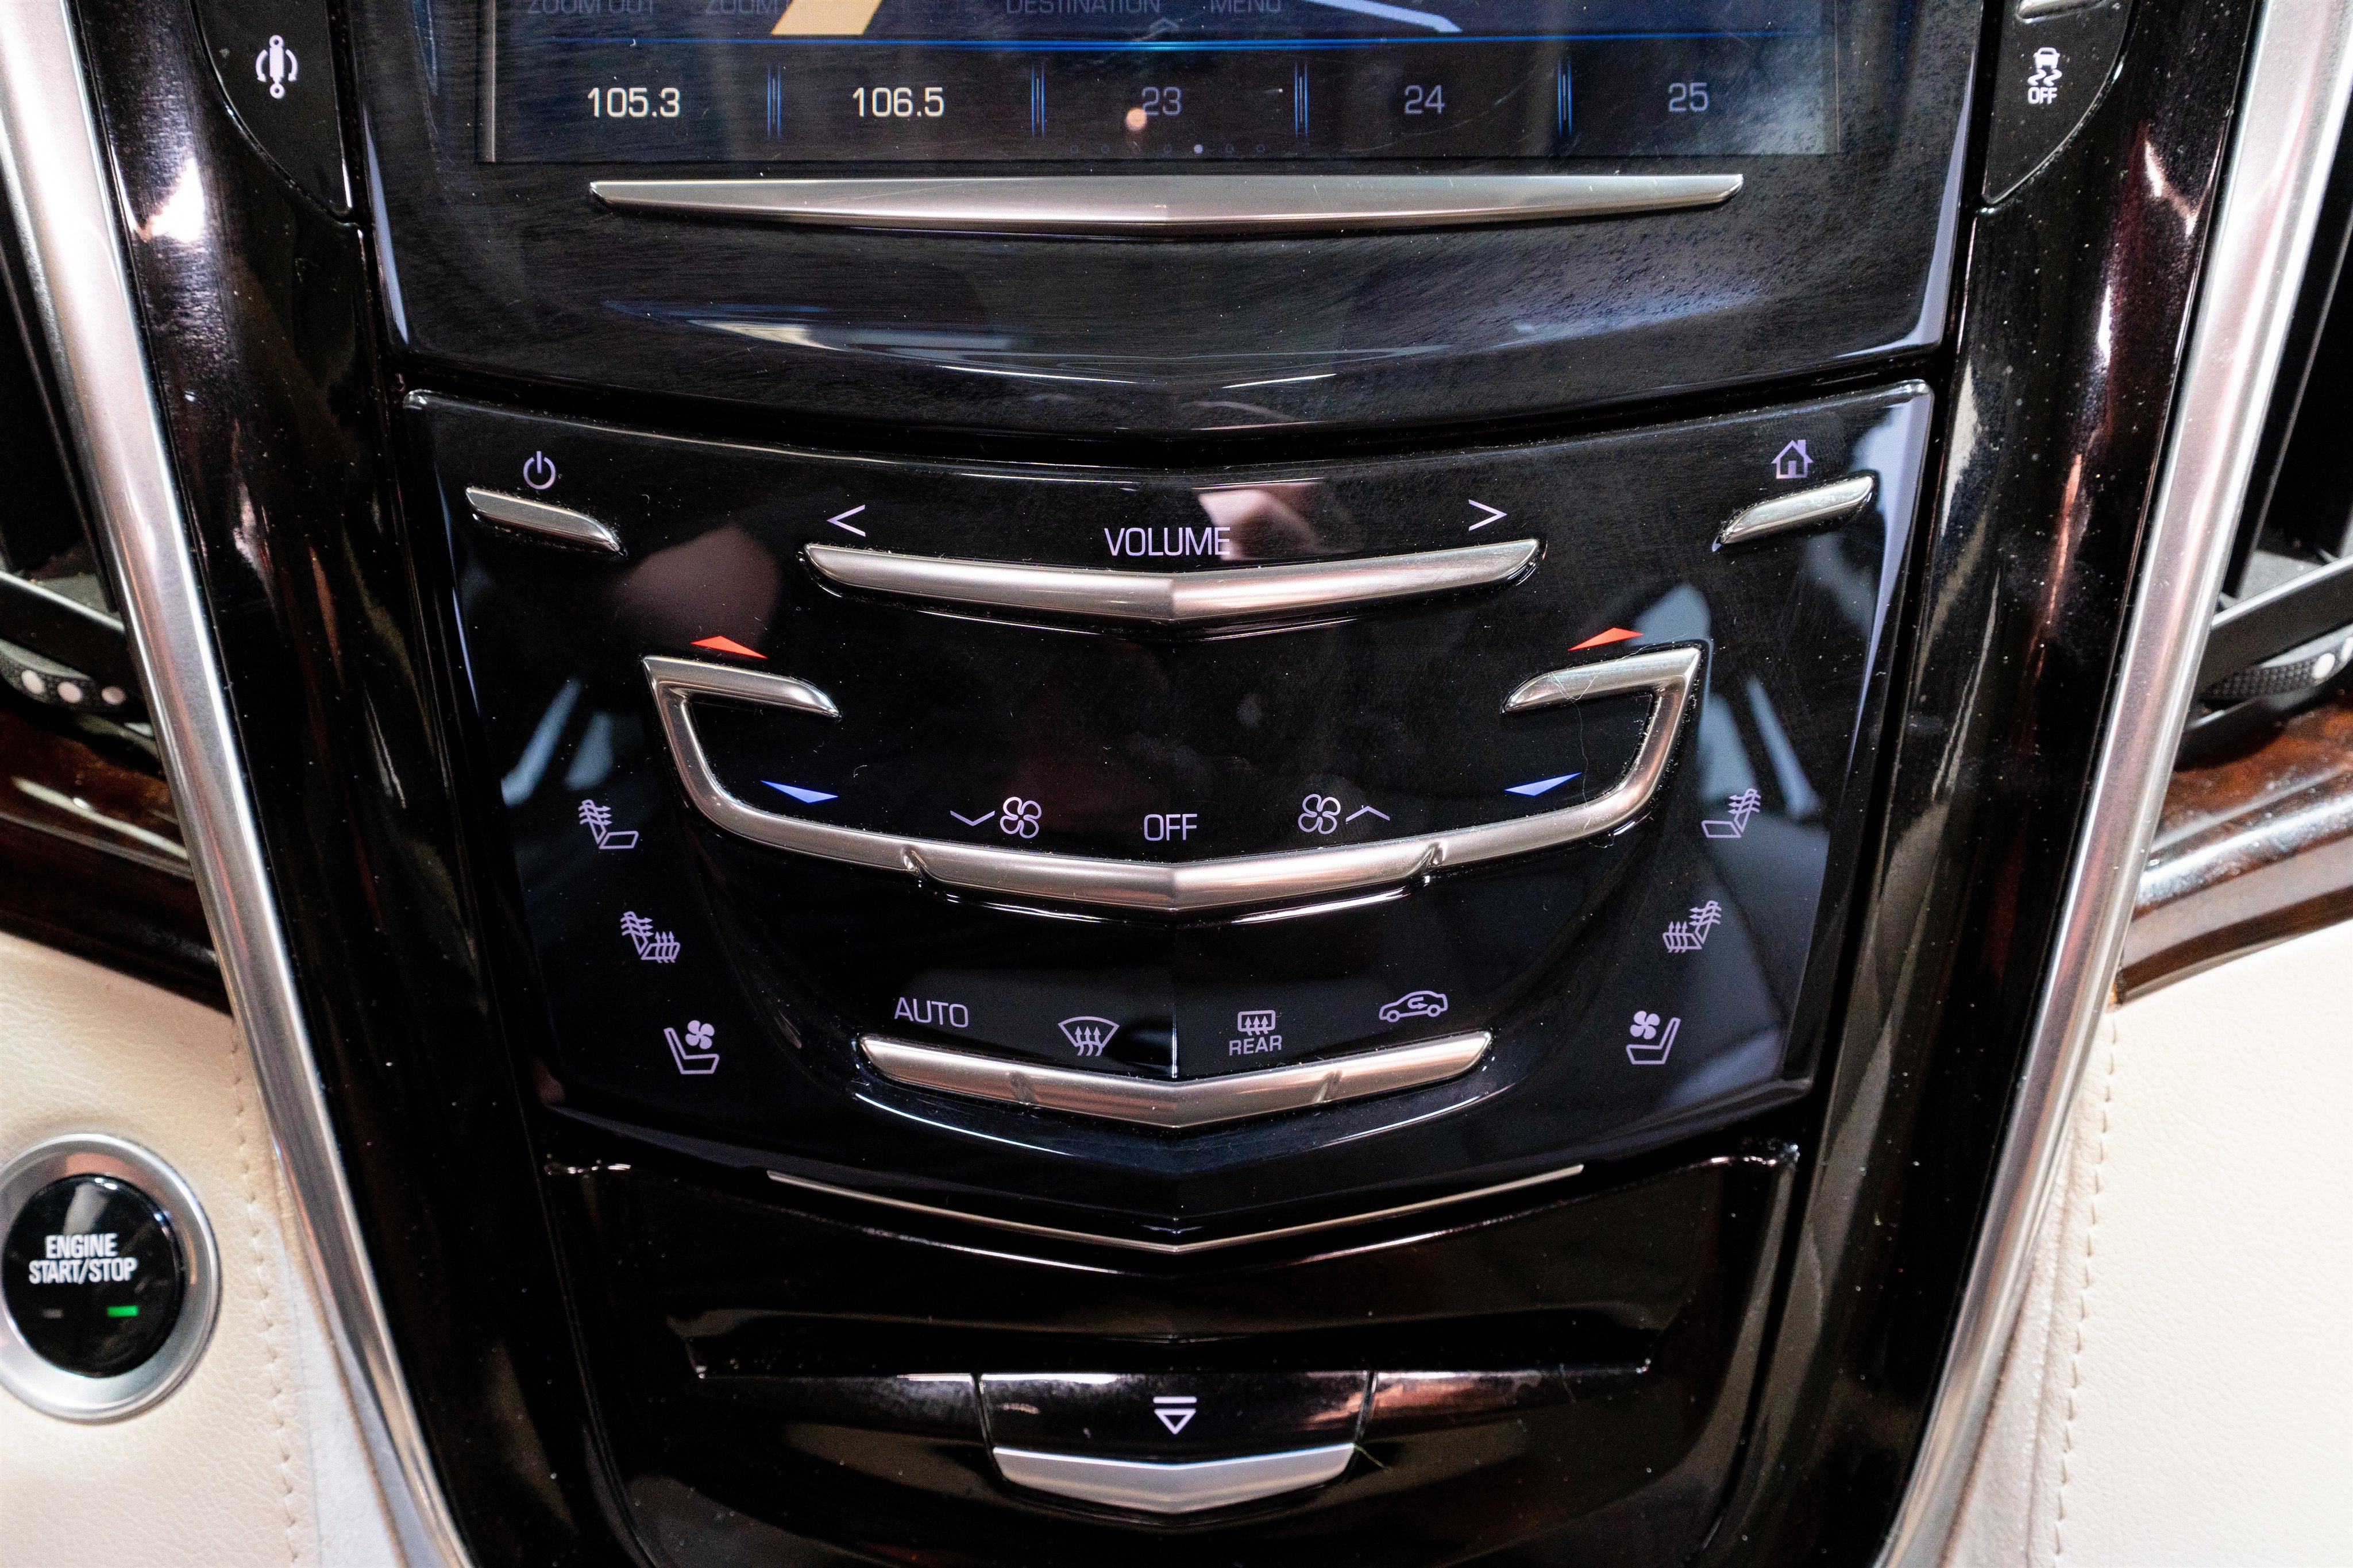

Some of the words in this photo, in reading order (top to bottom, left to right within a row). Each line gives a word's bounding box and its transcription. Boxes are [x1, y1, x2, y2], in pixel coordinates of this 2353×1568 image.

[588, 87, 680, 118] 105.3
[853, 87, 945, 117] 106.5
[1141, 87, 1182, 116] 23
[1404, 84, 1446, 115] 24
[1668, 82, 1710, 113] 25
[2027, 86, 2058, 105] OFF
[1104, 527, 1230, 557] VOLUME
[1144, 813, 1198, 841] OFF
[894, 997, 969, 1028] AUTO
[1229, 1034, 1282, 1056] REAR
[45, 1233, 118, 1260] ENGINE
[29, 1257, 138, 1284] START/STOP
